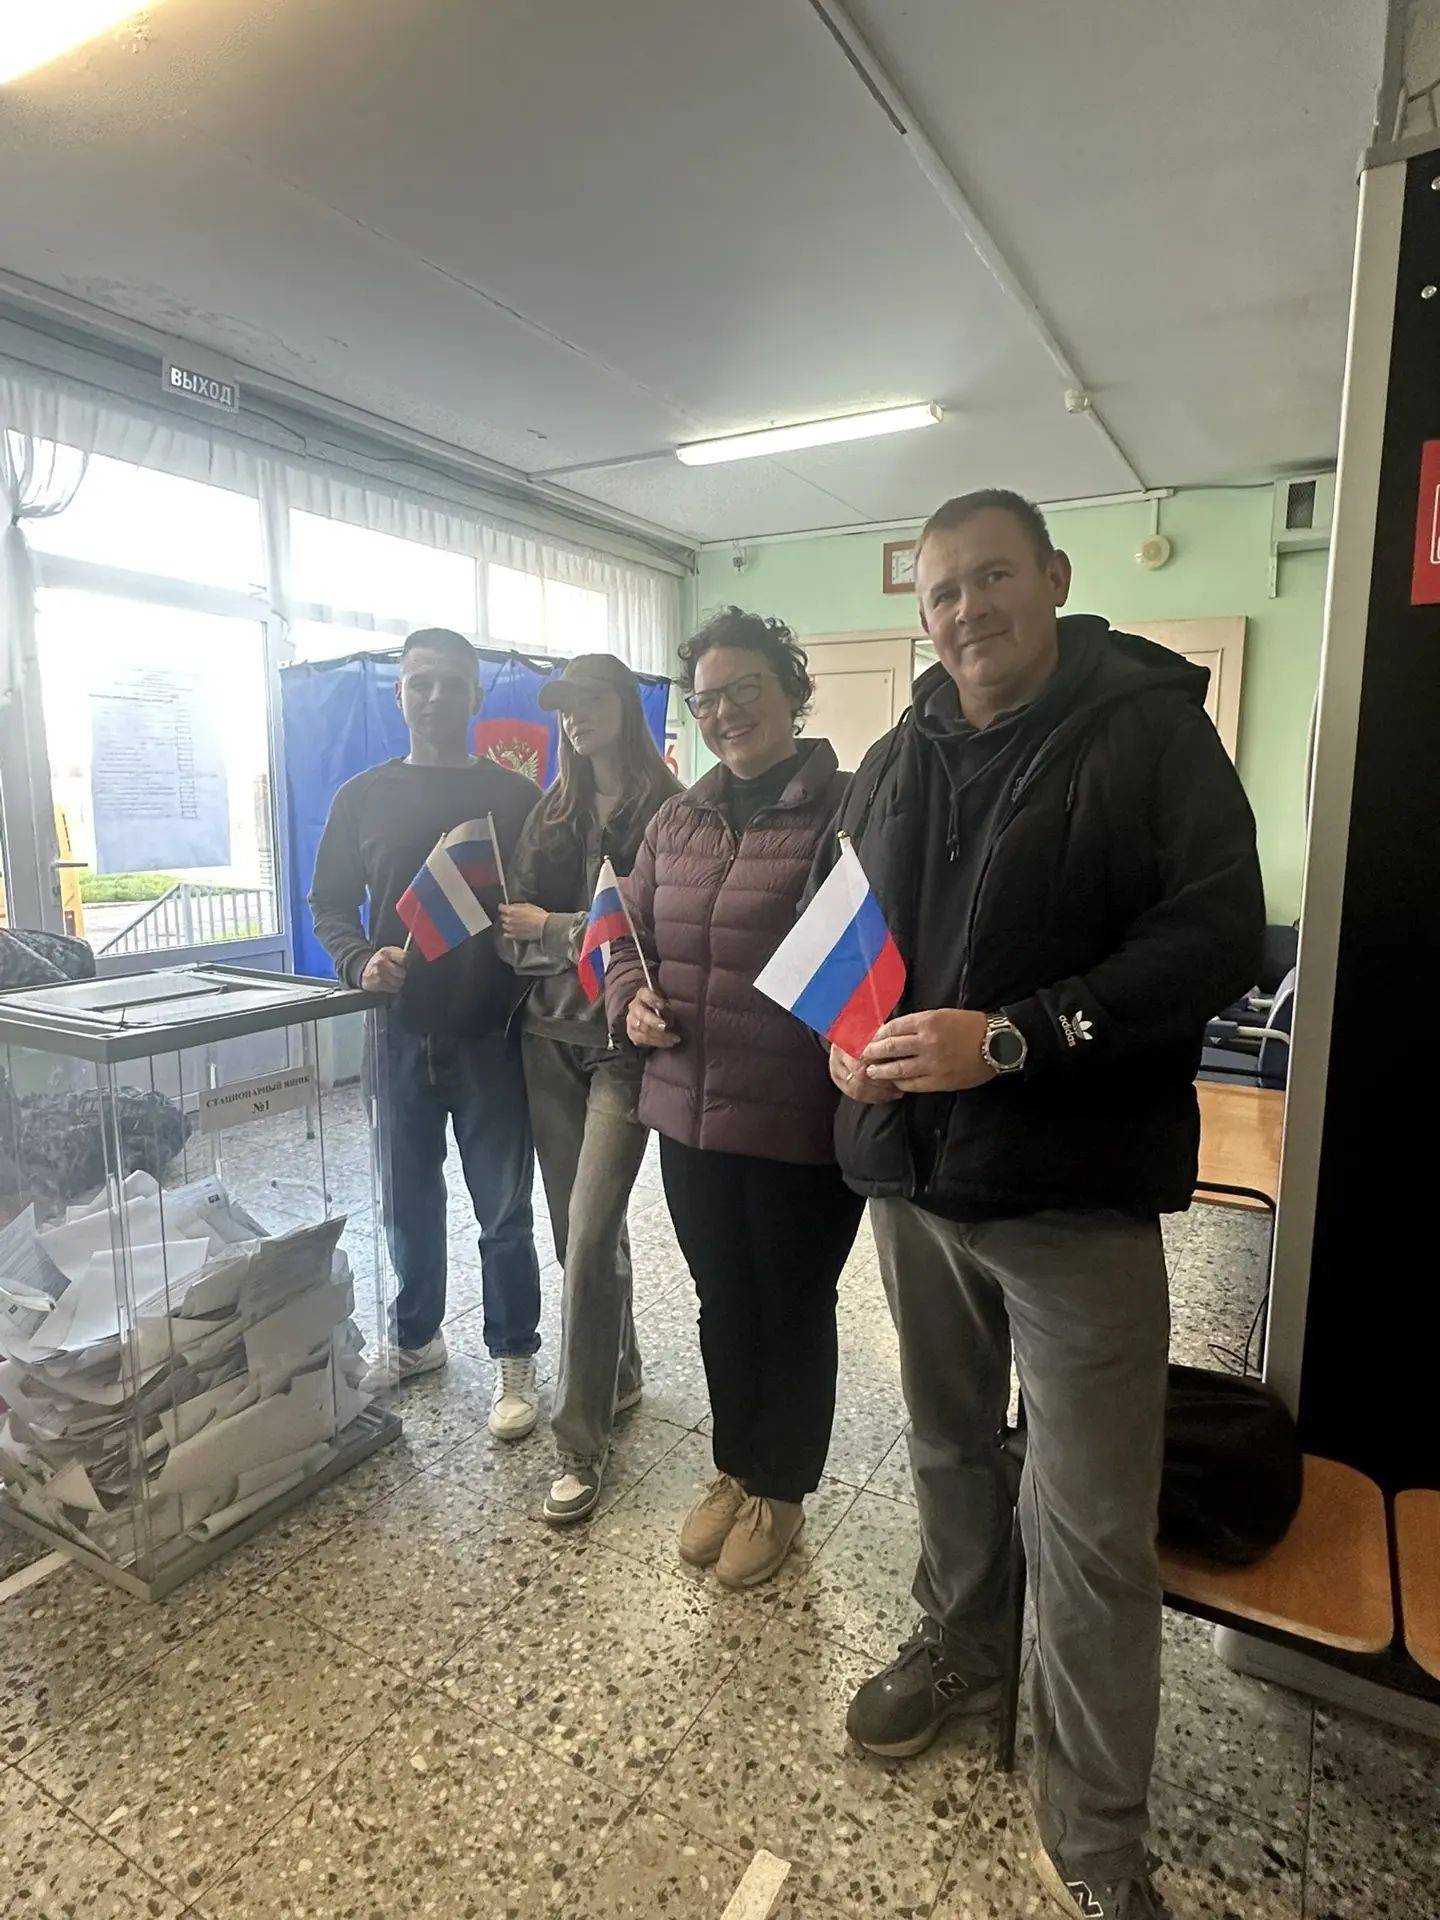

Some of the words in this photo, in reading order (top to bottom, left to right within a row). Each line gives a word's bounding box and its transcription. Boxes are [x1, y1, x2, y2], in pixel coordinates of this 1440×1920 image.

[171, 367, 231, 405] ВЫХОД
[1059, 1015, 1076, 1047] adidas
[206, 1082, 282, 1108] СТАЦИОНАРНЫЙ
[252, 1100, 270, 1114] №1
